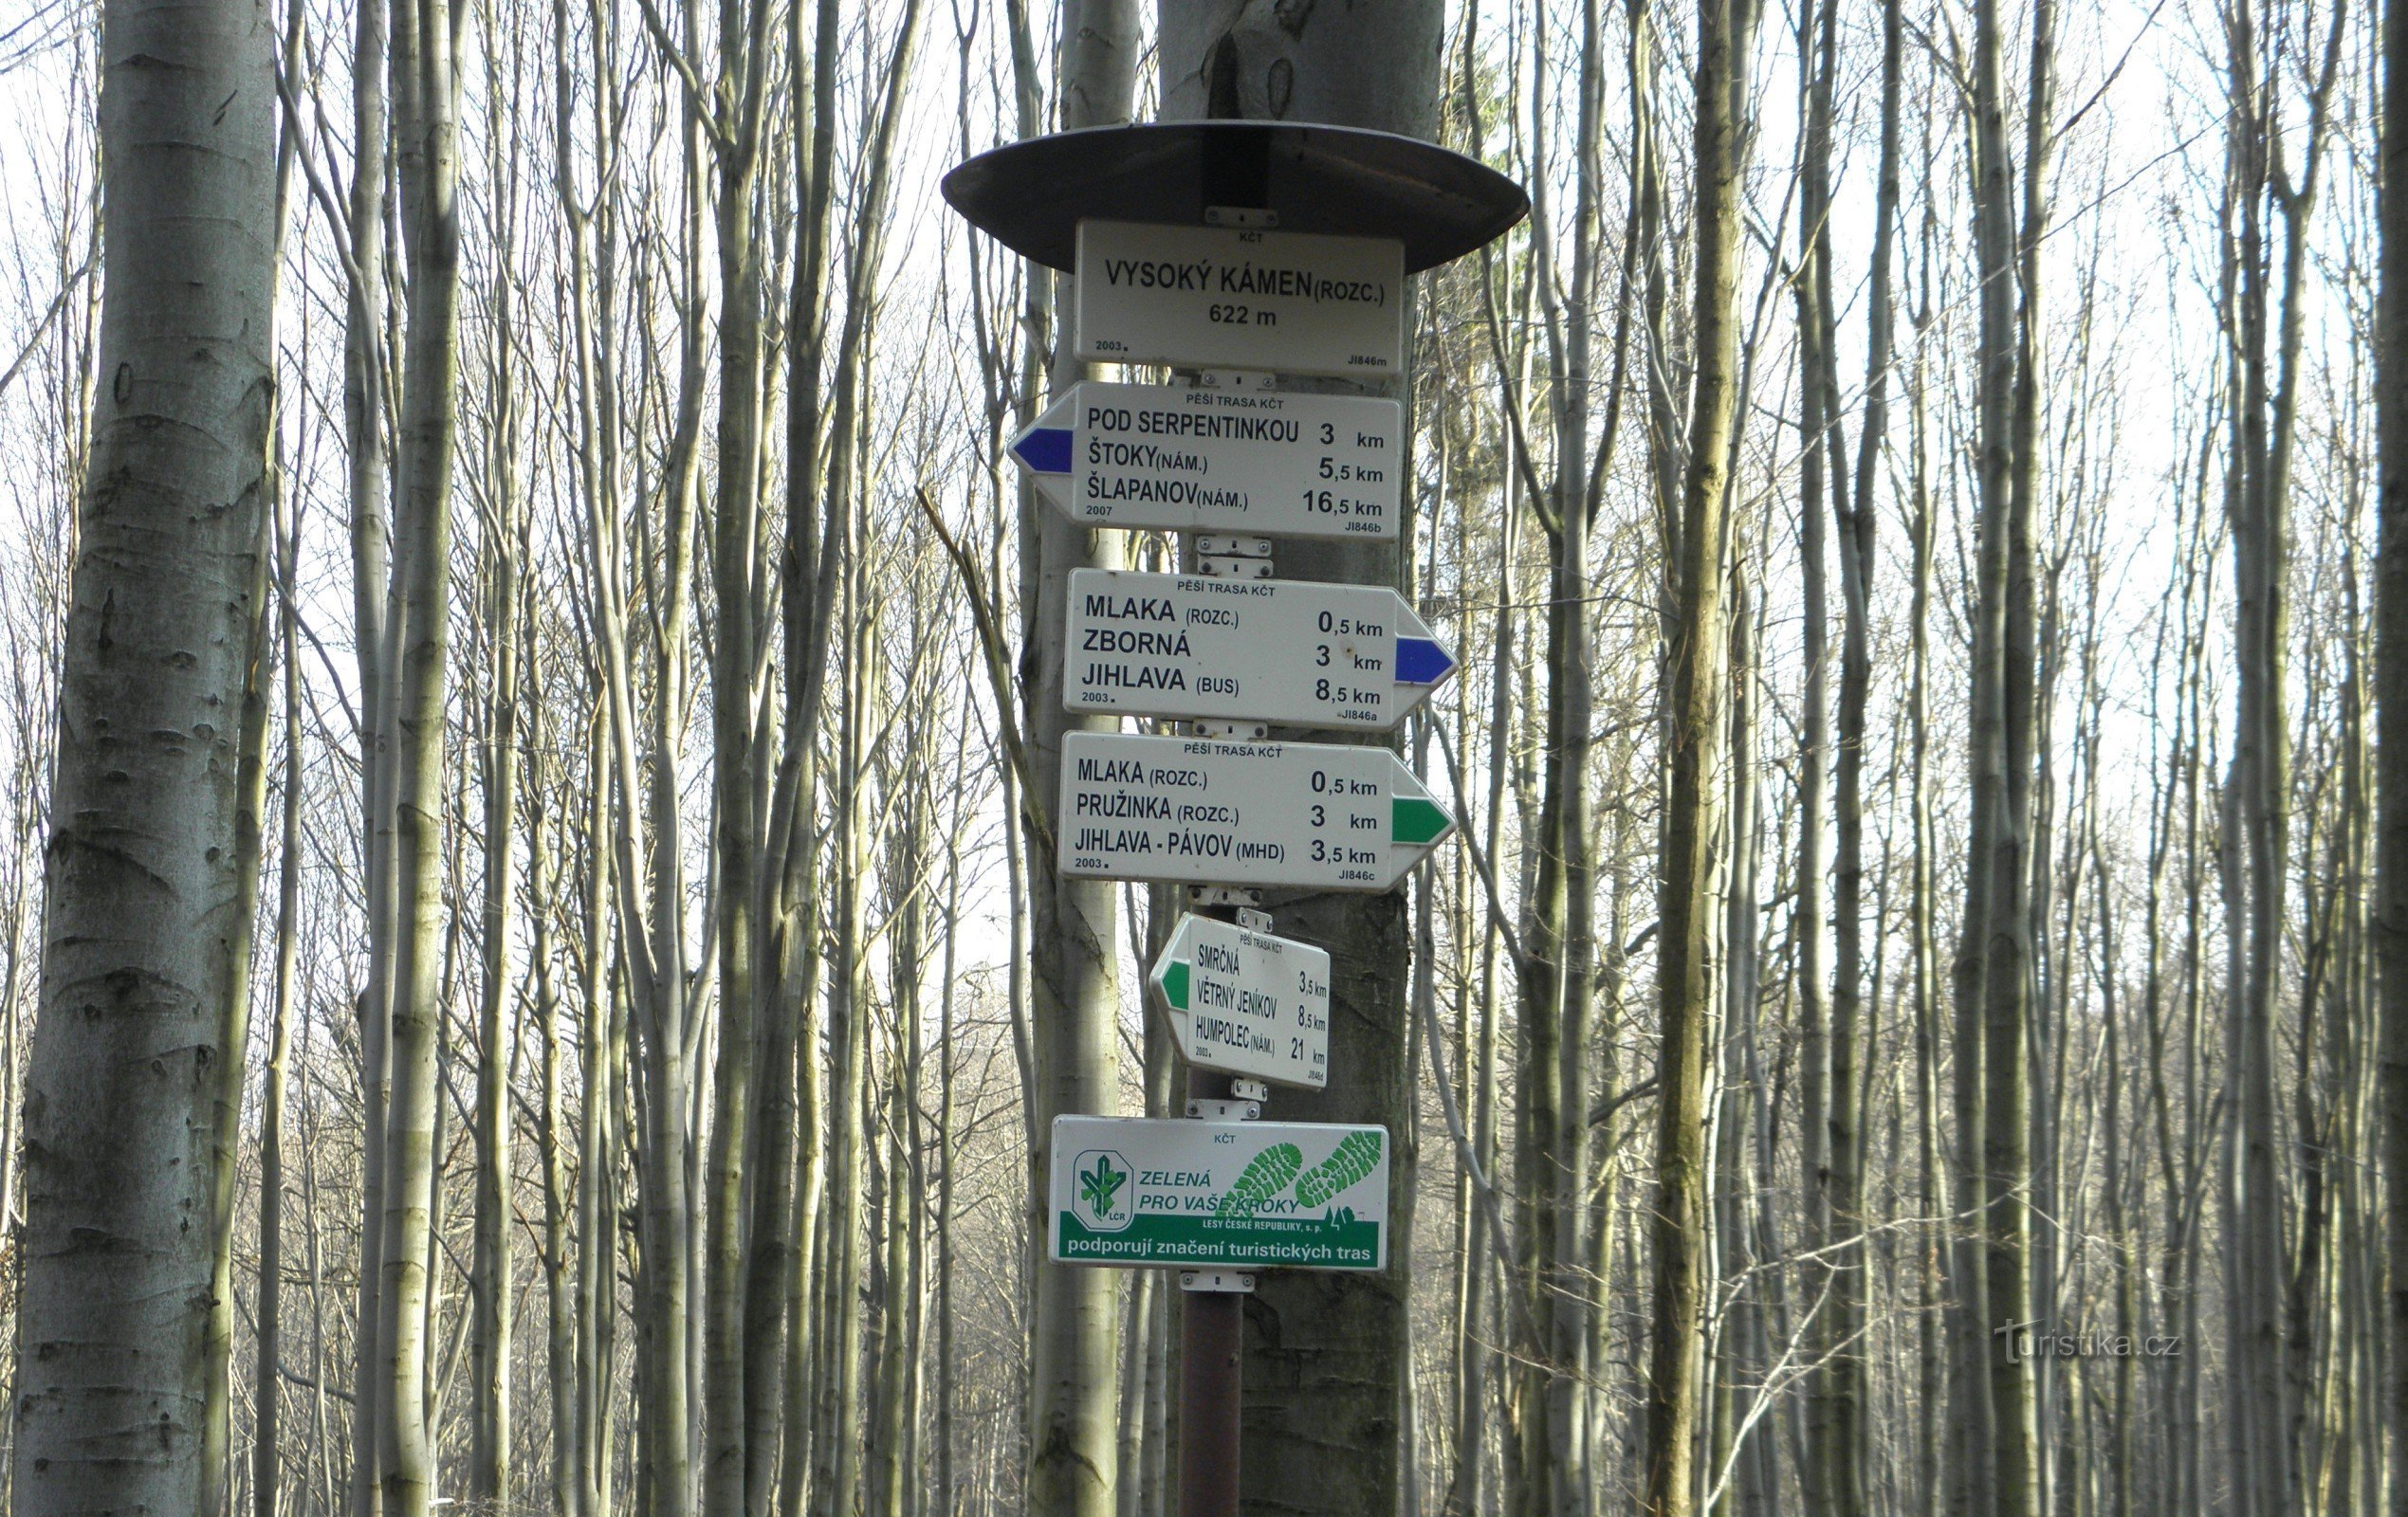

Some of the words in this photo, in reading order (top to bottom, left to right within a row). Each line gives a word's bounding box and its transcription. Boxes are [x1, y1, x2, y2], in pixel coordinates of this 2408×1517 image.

[1240, 231, 1263, 243] KČT
[1106, 259, 1213, 291] VYSOKÝ
[1209, 304, 1248, 324] 622
[1258, 309, 1277, 325] m
[1186, 393, 1213, 406] PĚŠÍ
[1216, 395, 1257, 408] TRASA
[1259, 396, 1284, 410] KČT
[1089, 408, 1131, 430] POD
[1138, 411, 1299, 443] SERPENTINKOU
[1319, 423, 1334, 445] 3
[1357, 432, 1384, 448] km
[1318, 457, 1350, 482] 5,5
[1356, 466, 1383, 482] km
[1086, 505, 1112, 516] 2007
[1303, 490, 1350, 515] 16,5
[1355, 500, 1382, 516] km
[1177, 580, 1204, 593] PĚŠÍ
[1207, 582, 1248, 594] TRASA
[1251, 584, 1276, 597] KČT
[1086, 594, 1176, 621] MLAKA
[1186, 609, 1239, 629] (ROZC.)
[1318, 611, 1350, 635] 0,5
[1355, 620, 1383, 636] km
[1083, 629, 1191, 657] ZBORNÁ
[1315, 645, 1330, 667] 3
[1354, 654, 1381, 670] km
[1082, 664, 1186, 691] JIHLAVA
[1196, 677, 1240, 697] (BUS)
[1315, 679, 1347, 704] 8,5
[1353, 688, 1380, 704] km
[1185, 743, 1211, 754] PĚŠÍ
[1215, 745, 1255, 757] TRASA
[1259, 745, 1282, 758] KČT
[1077, 758, 1144, 784] MLAKA
[1149, 770, 1207, 790] (ROZC.)
[1311, 771, 1344, 795] 0,5
[1351, 779, 1377, 795] km
[1076, 790, 1171, 819] PRUŽINKA
[1177, 806, 1240, 826] (ROZC.)
[1311, 805, 1325, 827] 3
[1350, 813, 1377, 830] km
[1075, 829, 1151, 853] JIHLAVA
[1167, 829, 1232, 857] PÁVOV
[1236, 841, 1285, 863] (MHD)
[1311, 840, 1343, 864] 3,5
[1349, 848, 1375, 864] km
[1240, 932, 1252, 947] PĚŠÍ
[1253, 938, 1271, 951] TRASA
[1272, 941, 1282, 954] KČT
[1199, 943, 1240, 976] SMRČNÁ
[1299, 971, 1313, 996] 3,5
[1315, 981, 1327, 998] km
[1197, 976, 1235, 1010] VĚTRNÝ
[1237, 988, 1277, 1019] JENÍKOV
[1298, 1005, 1312, 1028] 8,5
[1314, 1015, 1325, 1032] km
[1196, 1015, 1250, 1049] HUMPOLEC
[1291, 1037, 1304, 1060] 21
[1314, 1050, 1325, 1065] km
[1214, 1133, 1236, 1144] KČT
[1139, 1169, 1211, 1187] ZELENÁ
[1109, 1211, 1126, 1221] LČR
[1139, 1196, 1178, 1209] PRO
[1185, 1193, 1231, 1211] VAŠE
[1234, 1197, 1299, 1214] KROKY
[1203, 1218, 1223, 1229] LESY
[1224, 1217, 1252, 1230] ČESKÉ
[1254, 1220, 1303, 1233] REPUBLIKY,
[1068, 1236, 1152, 1255] podporují
[1156, 1239, 1223, 1255] značení
[1229, 1243, 1331, 1261] turistických
[1336, 1247, 1370, 1260] tras
